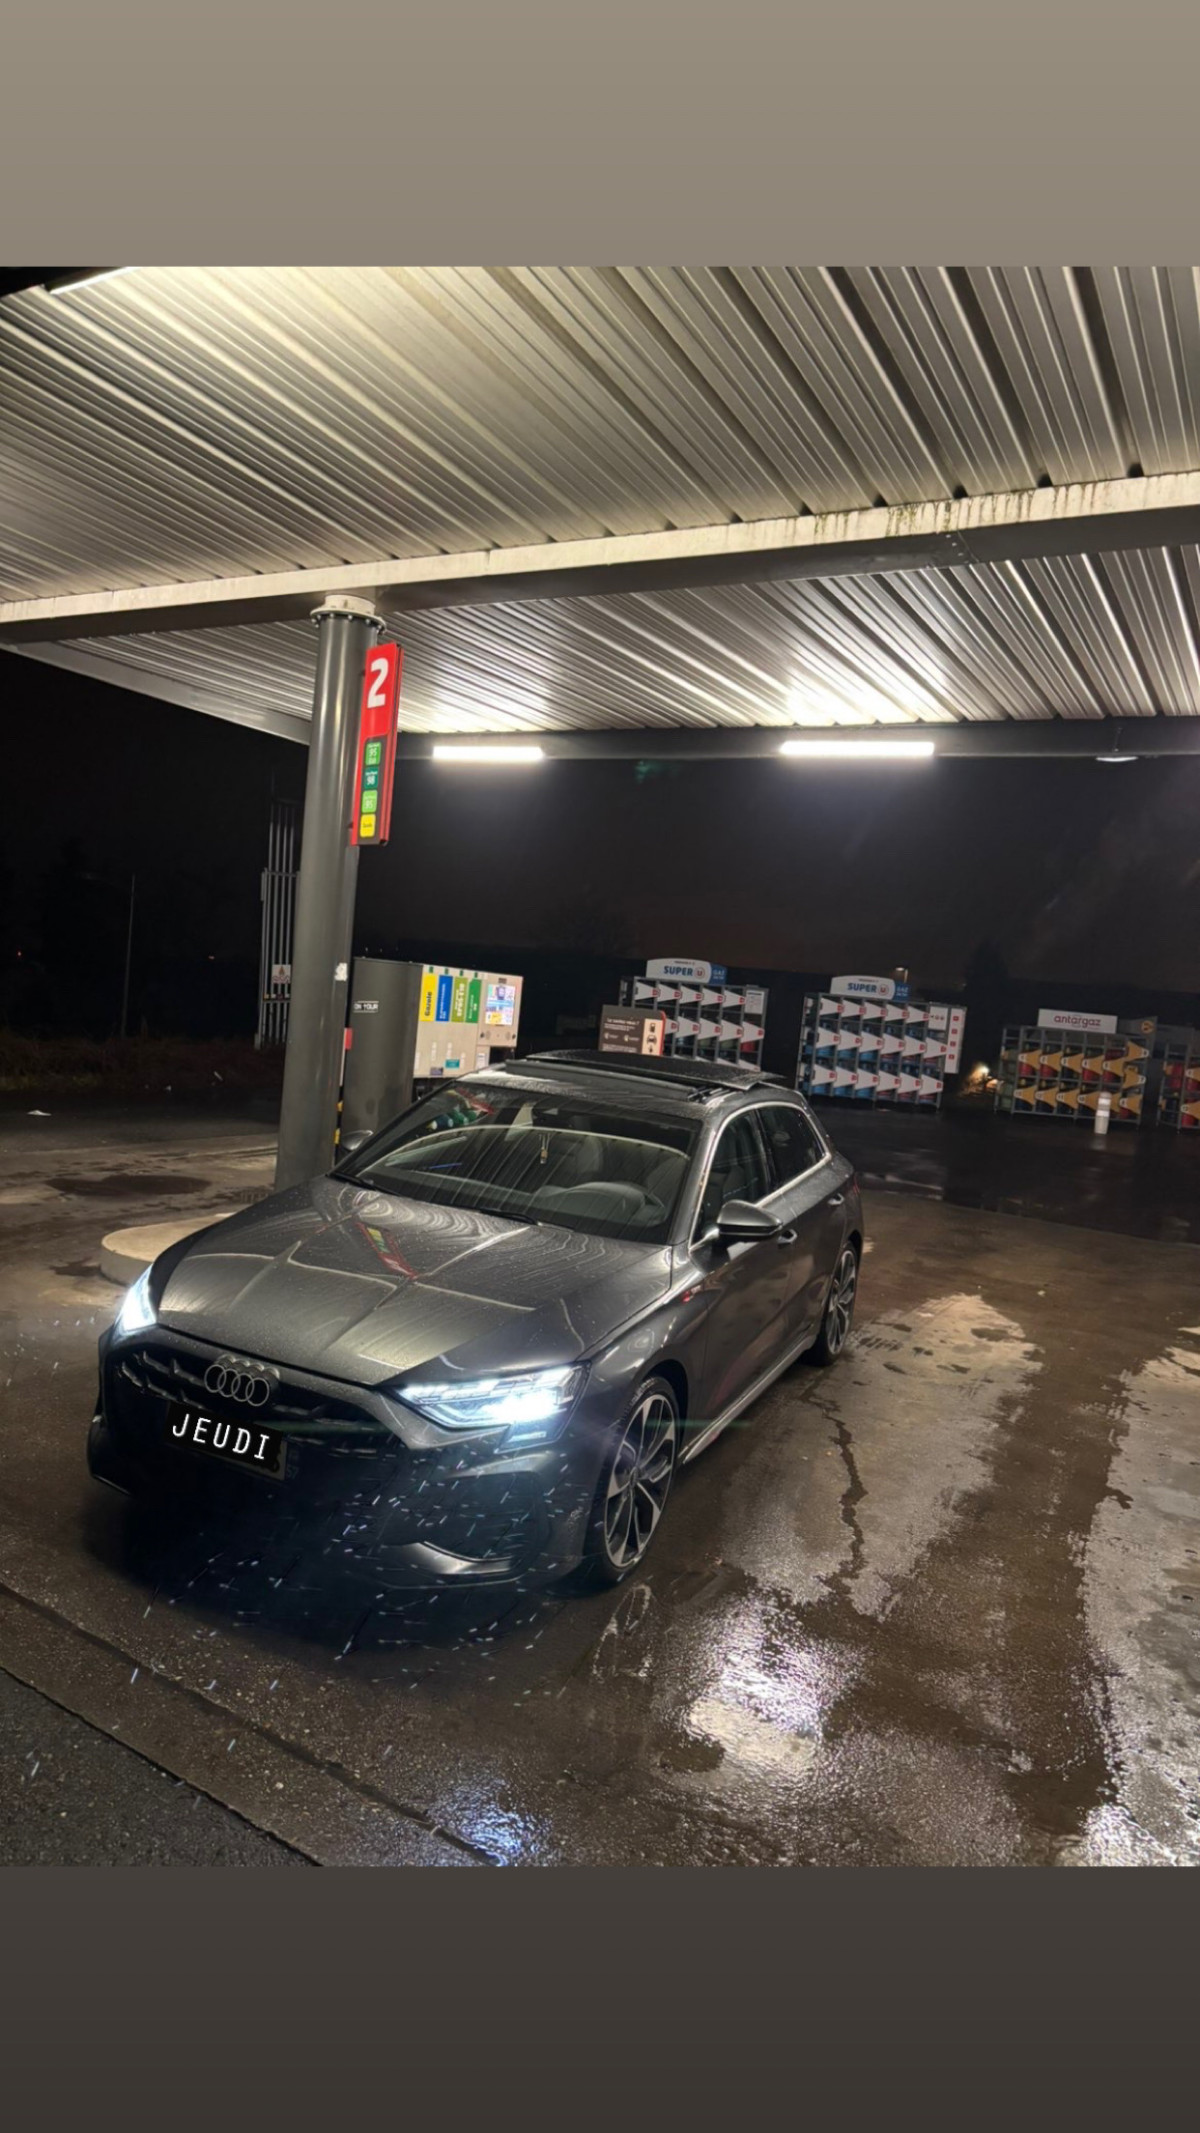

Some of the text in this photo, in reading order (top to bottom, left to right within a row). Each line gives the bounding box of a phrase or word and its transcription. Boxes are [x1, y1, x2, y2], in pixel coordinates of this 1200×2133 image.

[367, 657, 389, 708] 2
[368, 747, 377, 757] 95
[366, 775, 375, 785] 98
[663, 965, 694, 977] SUPER
[847, 982, 877, 993] SUPER
[1053, 1013, 1102, 1028] antargaz
